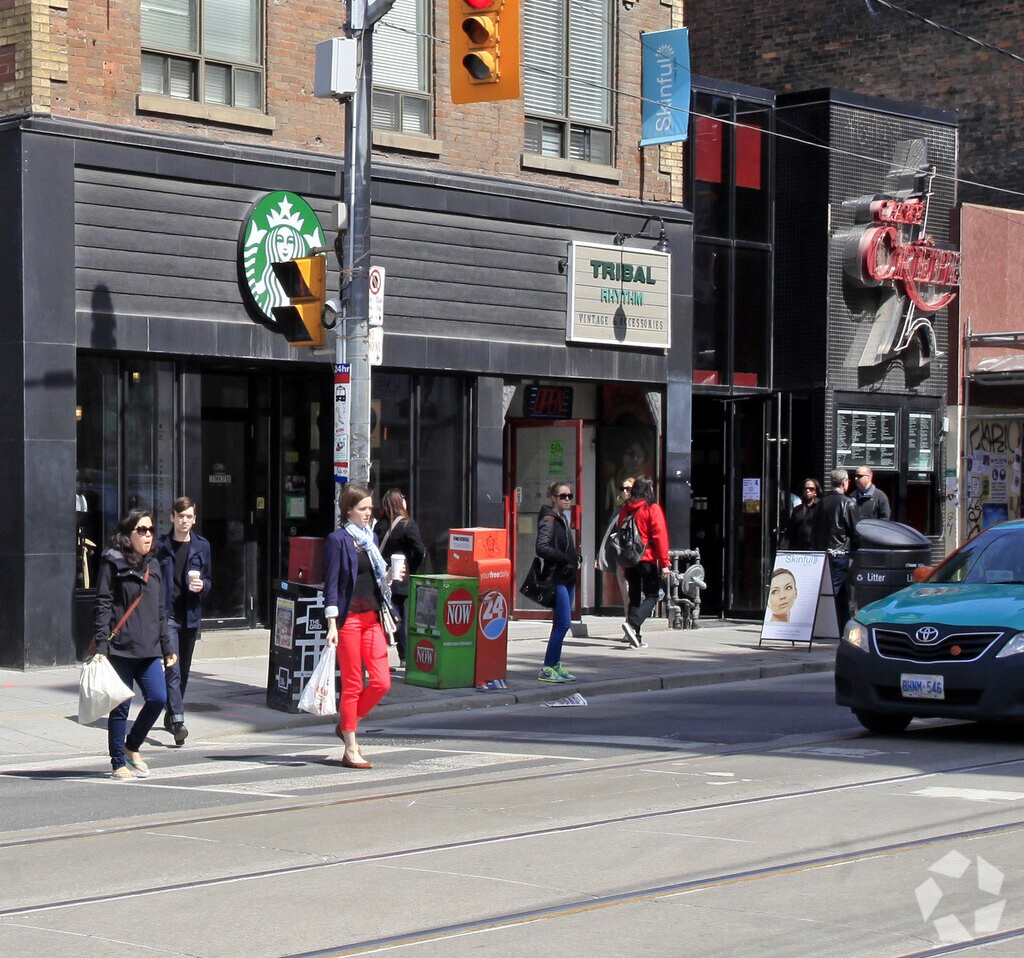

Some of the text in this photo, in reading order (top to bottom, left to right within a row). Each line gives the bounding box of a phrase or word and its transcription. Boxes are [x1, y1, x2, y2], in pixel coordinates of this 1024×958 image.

[656, 57, 673, 132] Skinful
[590, 260, 656, 285] TRIBAL
[600, 288, 644, 306] RHYTHM
[579, 314, 608, 325] VINTAGE
[785, 554, 813, 565] Skinful
[867, 572, 886, 582] Litter
[447, 603, 472, 625] NOW
[482, 595, 503, 620] 24
[416, 648, 433, 664] NOW
[926, 681, 942, 694] 546
